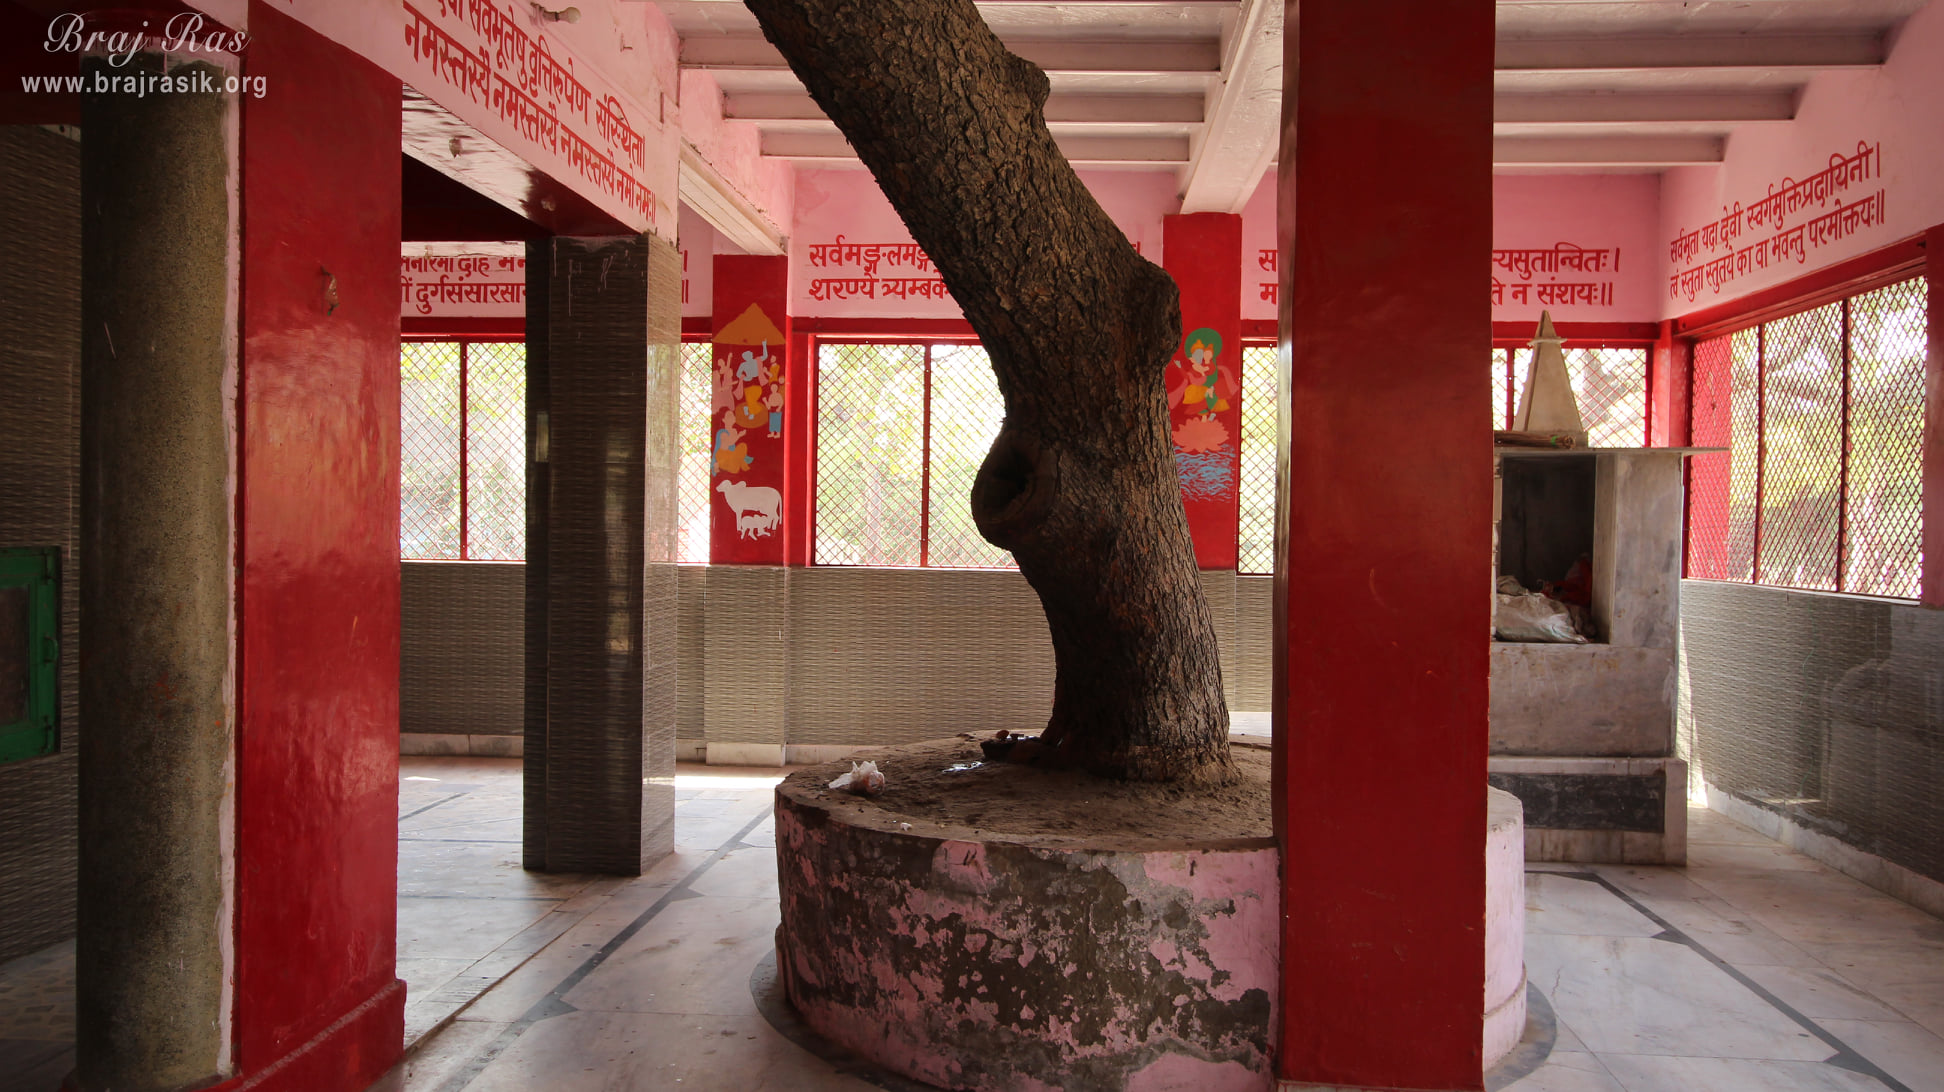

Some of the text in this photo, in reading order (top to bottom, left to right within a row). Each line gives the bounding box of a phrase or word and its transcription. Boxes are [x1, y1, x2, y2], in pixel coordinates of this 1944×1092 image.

[1702, 221, 1719, 252] यदा
[1720, 201, 1744, 249] देवी
[1737, 245, 1754, 276] का
[1755, 239, 1770, 269] वा
[1511, 283, 1532, 305] न
